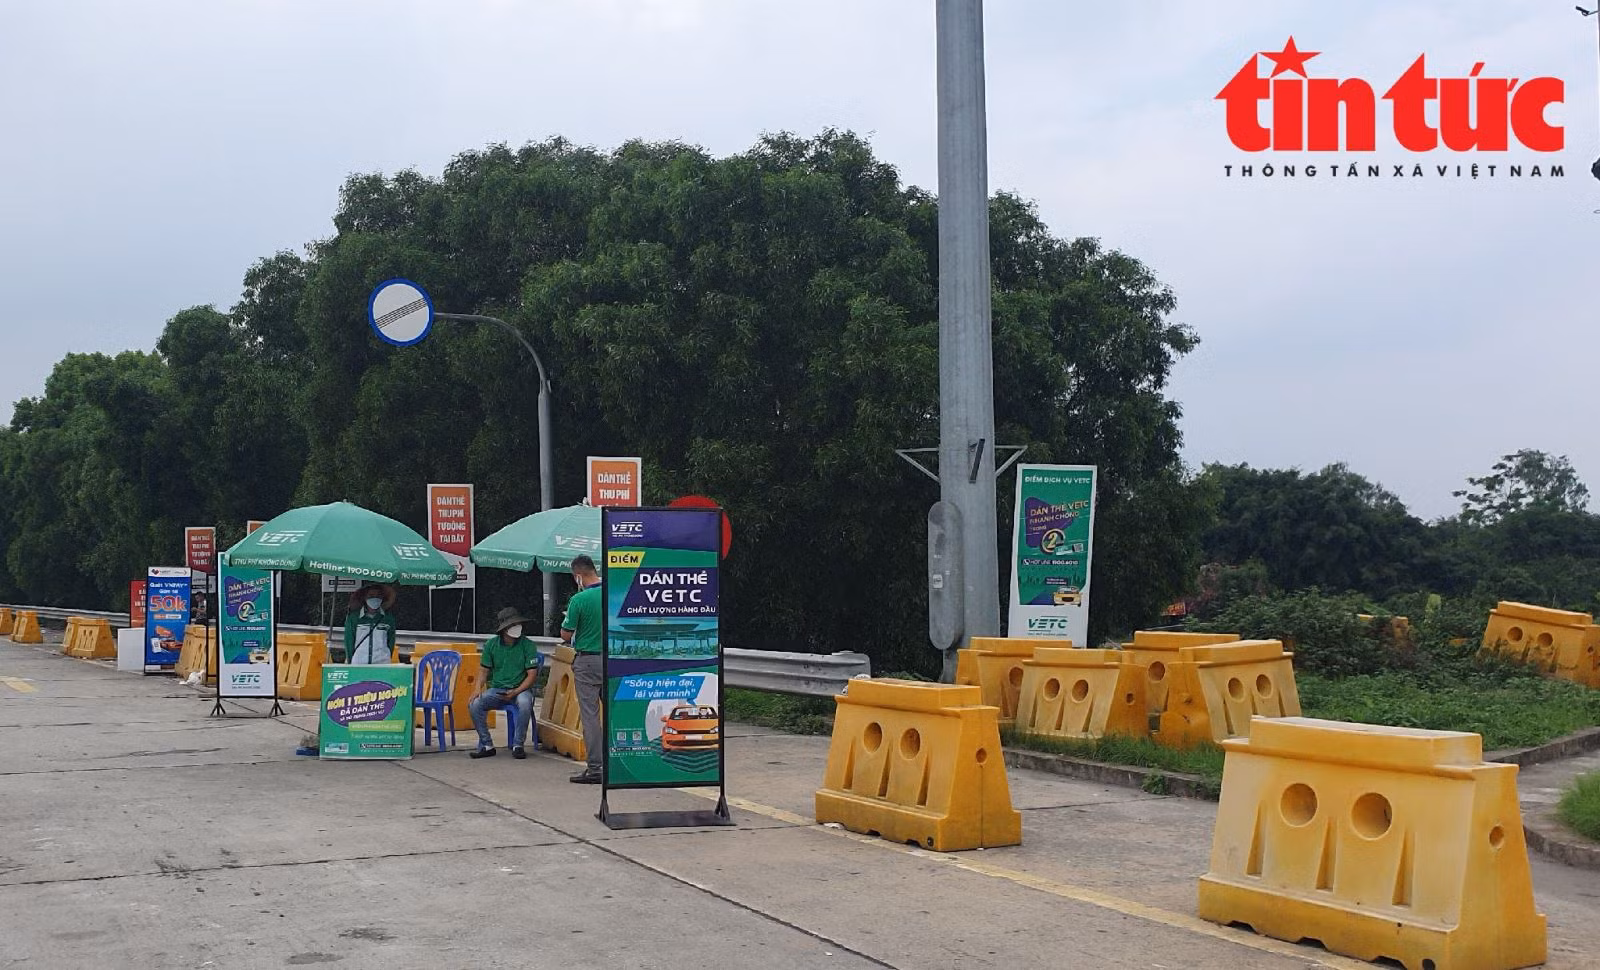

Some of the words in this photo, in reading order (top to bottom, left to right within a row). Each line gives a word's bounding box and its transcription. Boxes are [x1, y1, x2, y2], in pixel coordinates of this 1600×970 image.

[598, 472, 615, 484] DÁN
[599, 489, 615, 499] THU
[616, 488, 630, 500] PHÍ
[1068, 500, 1089, 510] VETC
[611, 523, 643, 532] VETC
[257, 531, 305, 544] VETC
[555, 535, 601, 550] VET
[1047, 532, 1058, 549] 2
[393, 544, 429, 558] VETC
[543, 559, 559, 567] THU
[610, 553, 639, 563] ĐIỂM
[309, 560, 345, 573] Hotline:
[347, 566, 370, 576] 1900
[370, 570, 393, 579] 6010
[639, 571, 674, 585] DÁN
[677, 570, 708, 585] THẺ
[645, 589, 702, 603] VETC
[150, 595, 188, 612] 50k
[627, 606, 648, 614] CHẤT
[648, 606, 677, 615] LƯỢNG
[700, 605, 716, 613] ĐẦU
[1028, 618, 1068, 629] VETC
[231, 674, 261, 683] VETC
[656, 678, 676, 688] hiện
[634, 689, 646, 698] lái
